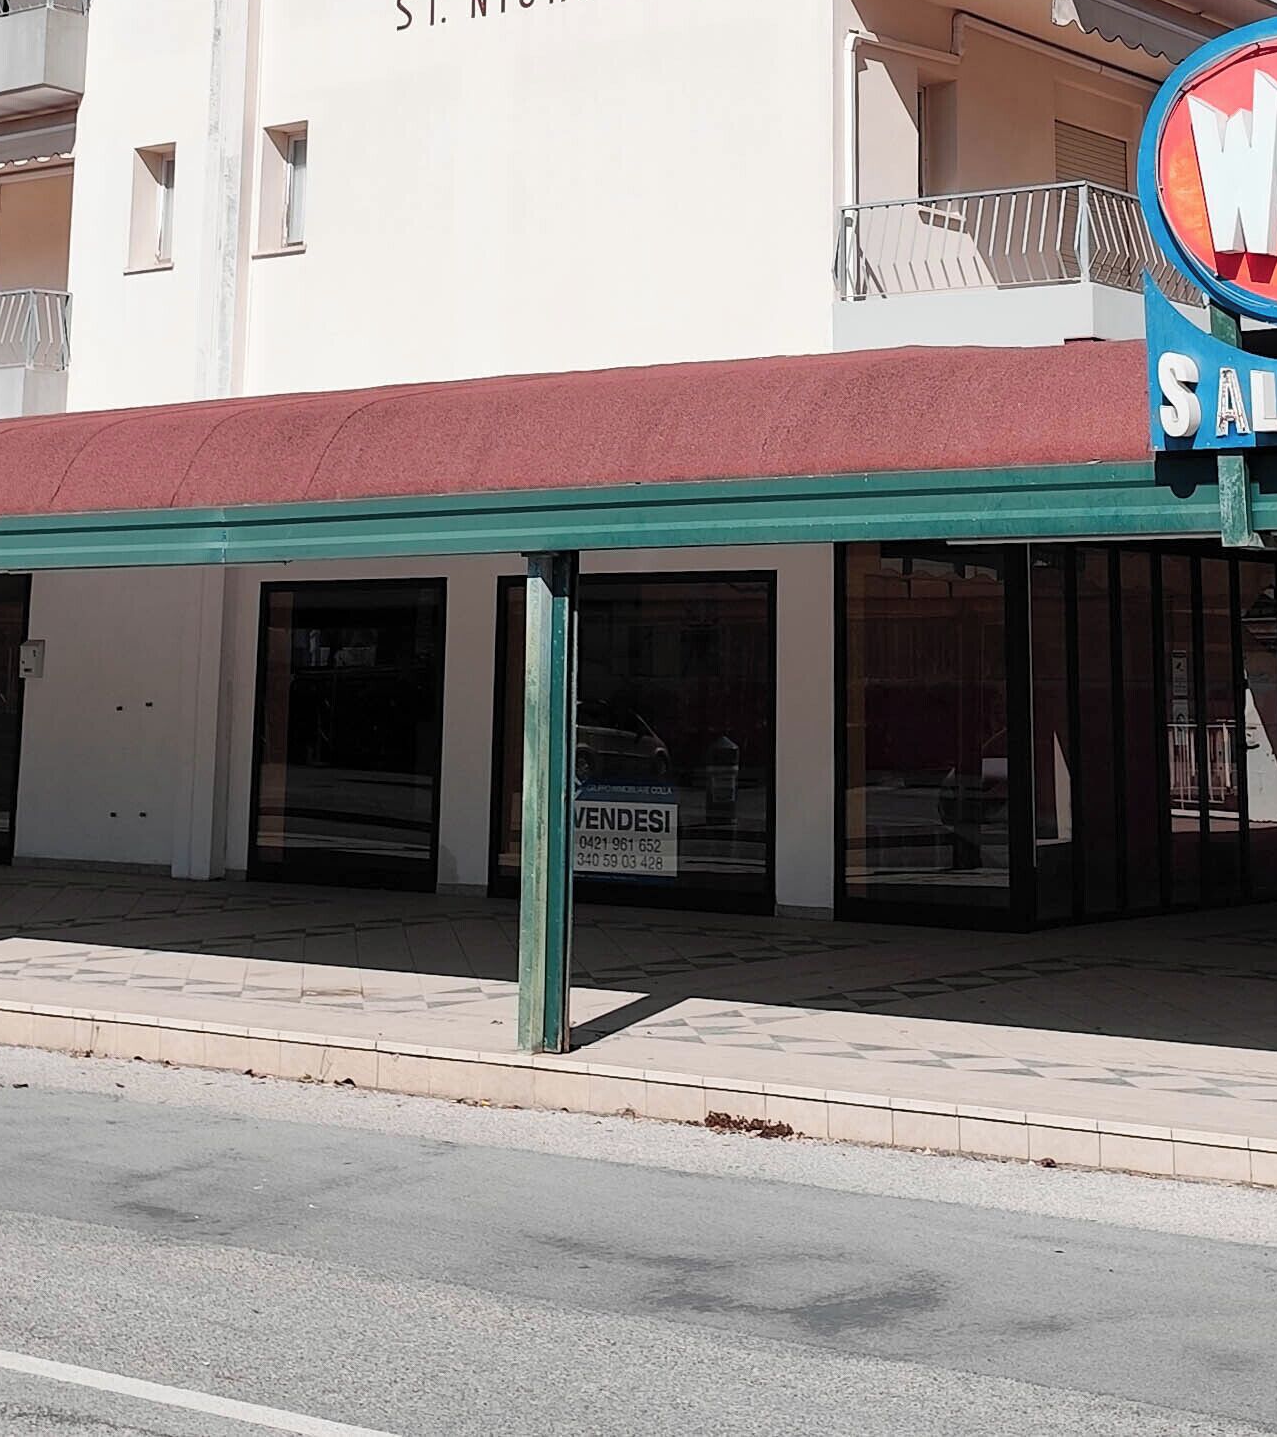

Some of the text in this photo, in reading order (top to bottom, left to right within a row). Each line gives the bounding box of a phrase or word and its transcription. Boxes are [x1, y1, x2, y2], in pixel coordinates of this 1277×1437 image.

[574, 807, 670, 833] VENDESI
[579, 835, 662, 854] 0421 961 652
[577, 852, 663, 871] 340 59 03 428
